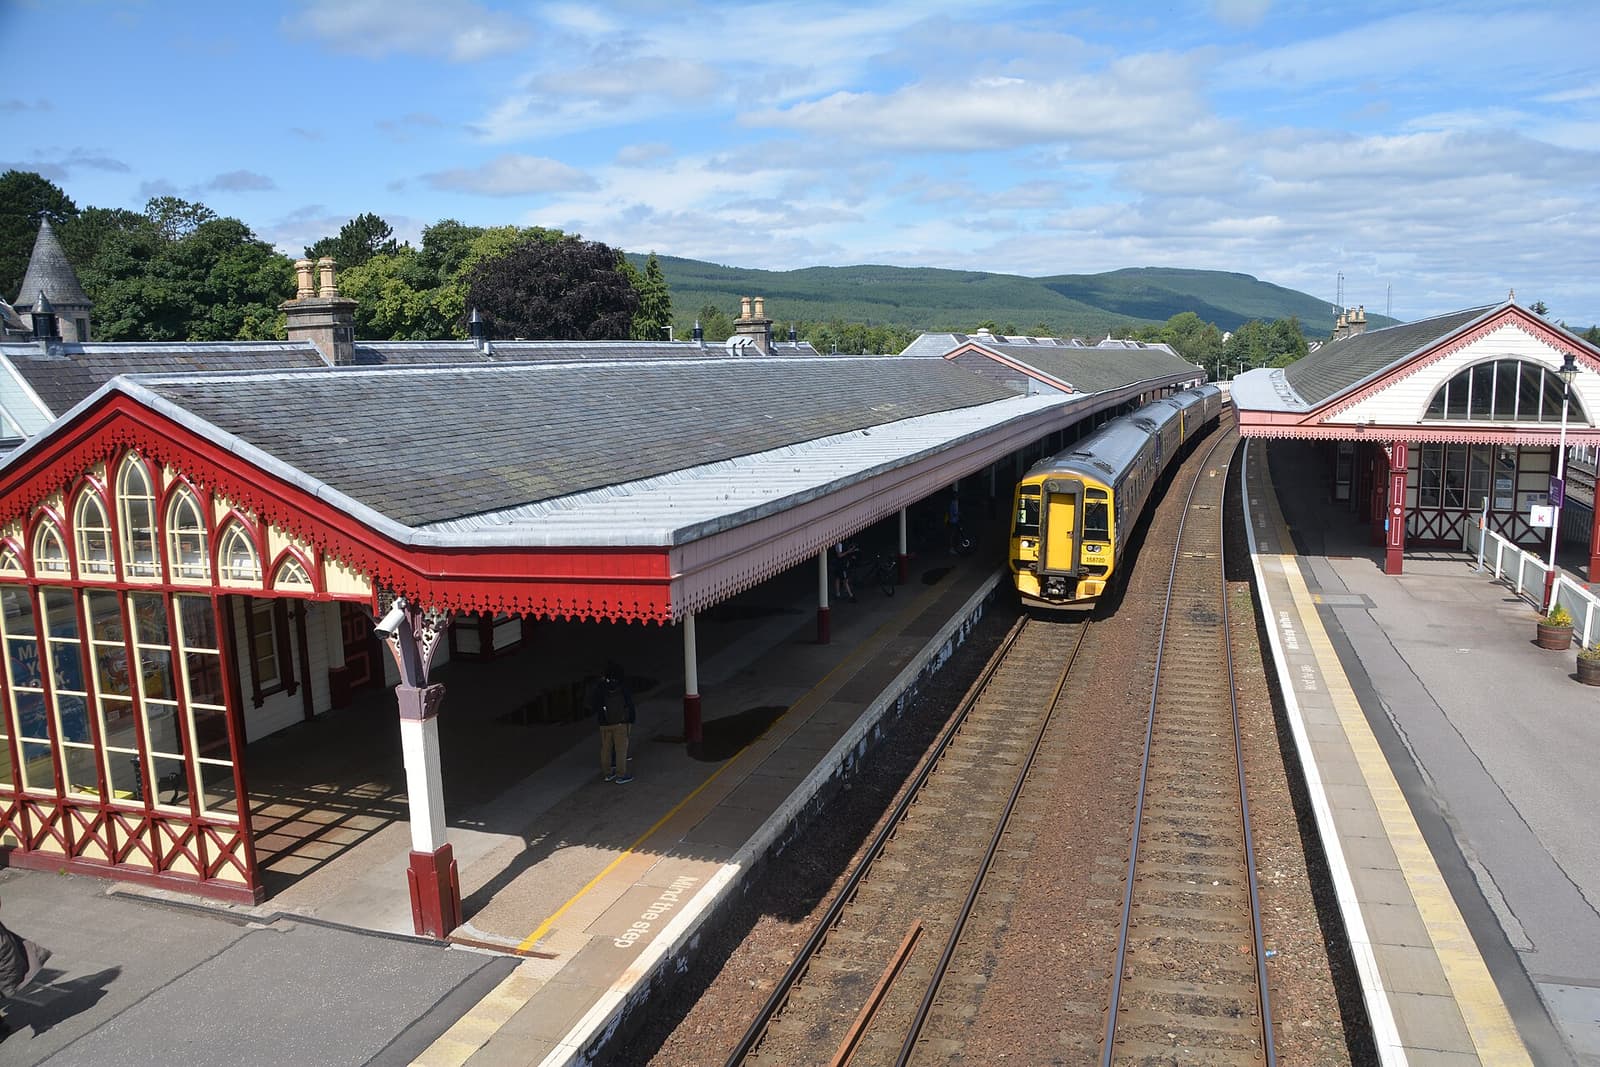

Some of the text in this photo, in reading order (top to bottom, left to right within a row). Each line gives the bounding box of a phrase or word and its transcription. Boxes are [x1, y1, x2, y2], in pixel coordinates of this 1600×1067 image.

[1538, 514, 1545, 522] K
[613, 876, 698, 948] Mind the step
